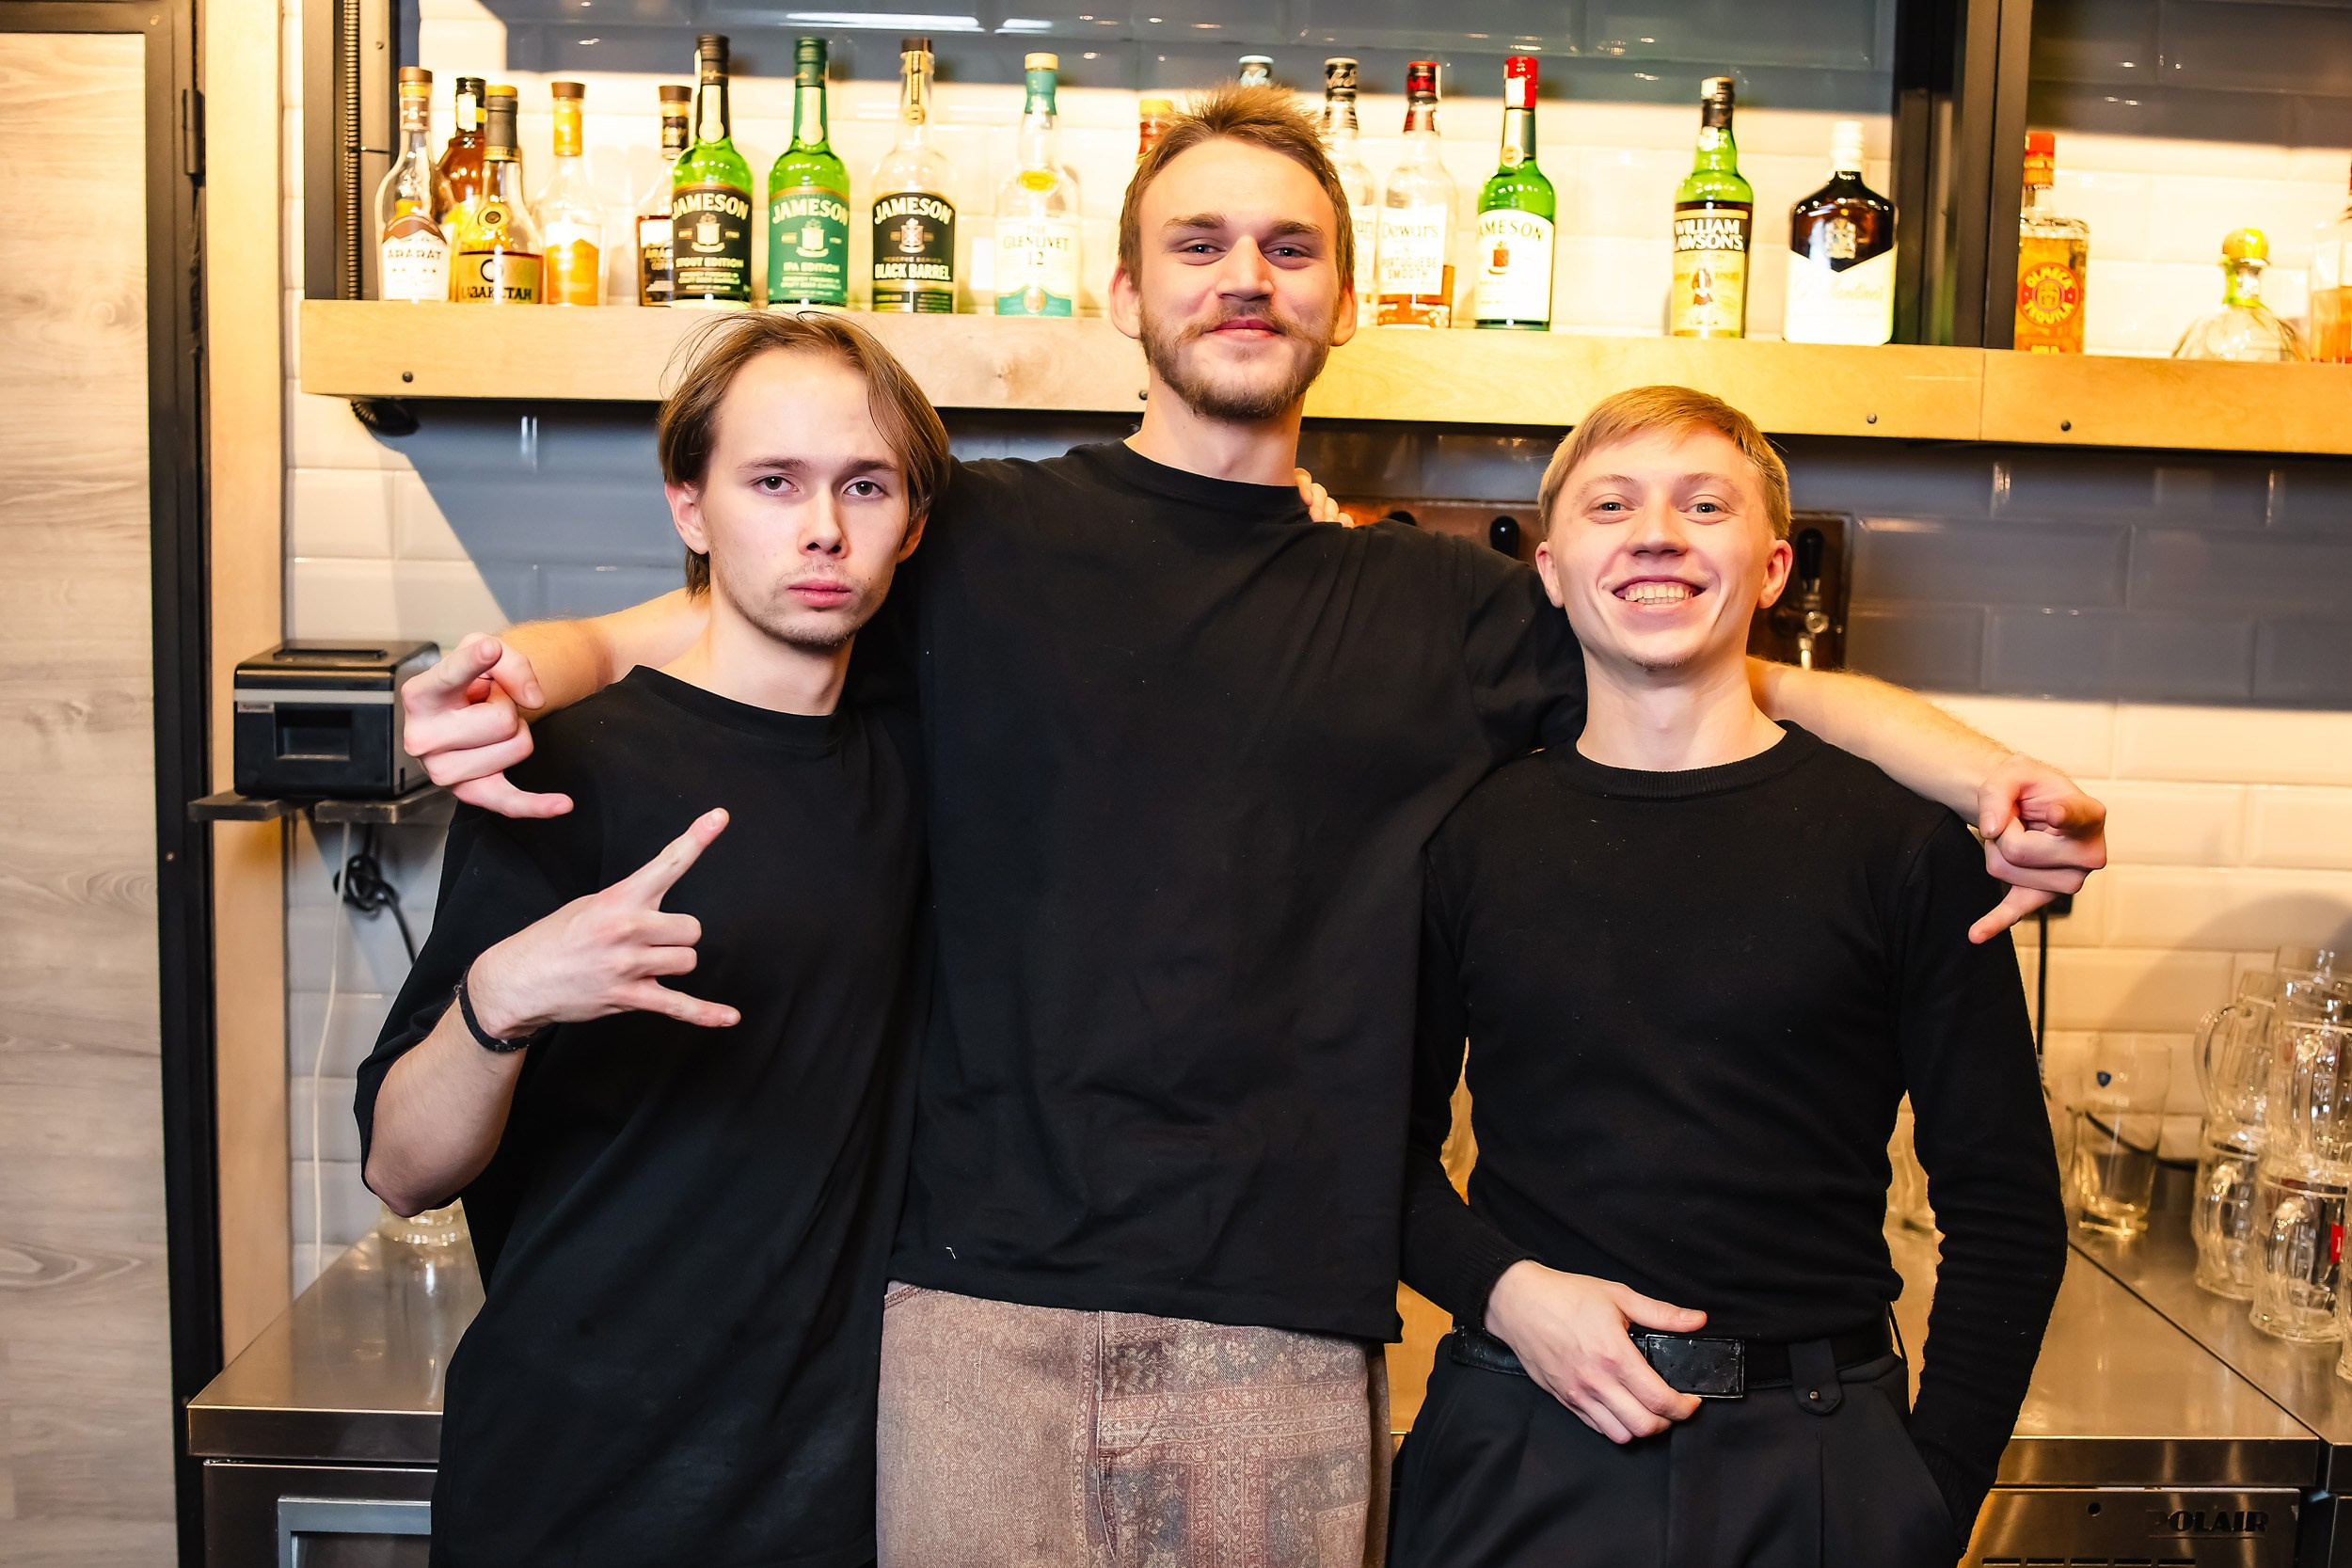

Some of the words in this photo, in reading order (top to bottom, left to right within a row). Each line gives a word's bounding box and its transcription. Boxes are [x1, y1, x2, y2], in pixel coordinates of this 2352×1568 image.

[672, 193, 749, 220] JAMESON
[771, 198, 848, 226] JAMESON
[874, 197, 952, 225] JAMESON
[1476, 218, 1544, 241] AMESON
[1675, 218, 1740, 235] WILLIAM
[1003, 235, 1069, 251] GLENLIVET
[388, 248, 442, 261] ARARAT
[675, 256, 704, 268] STOUT
[704, 257, 744, 268] EDITION
[1028, 251, 1044, 265] 12
[801, 262, 840, 273] EDITION
[874, 263, 908, 279] BLACK
[908, 263, 951, 280] BARREL
[2025, 267, 2073, 290] OLMECA
[2024, 299, 2074, 325] TEQUILA
[2145, 1510, 2269, 1532] POLAIR
